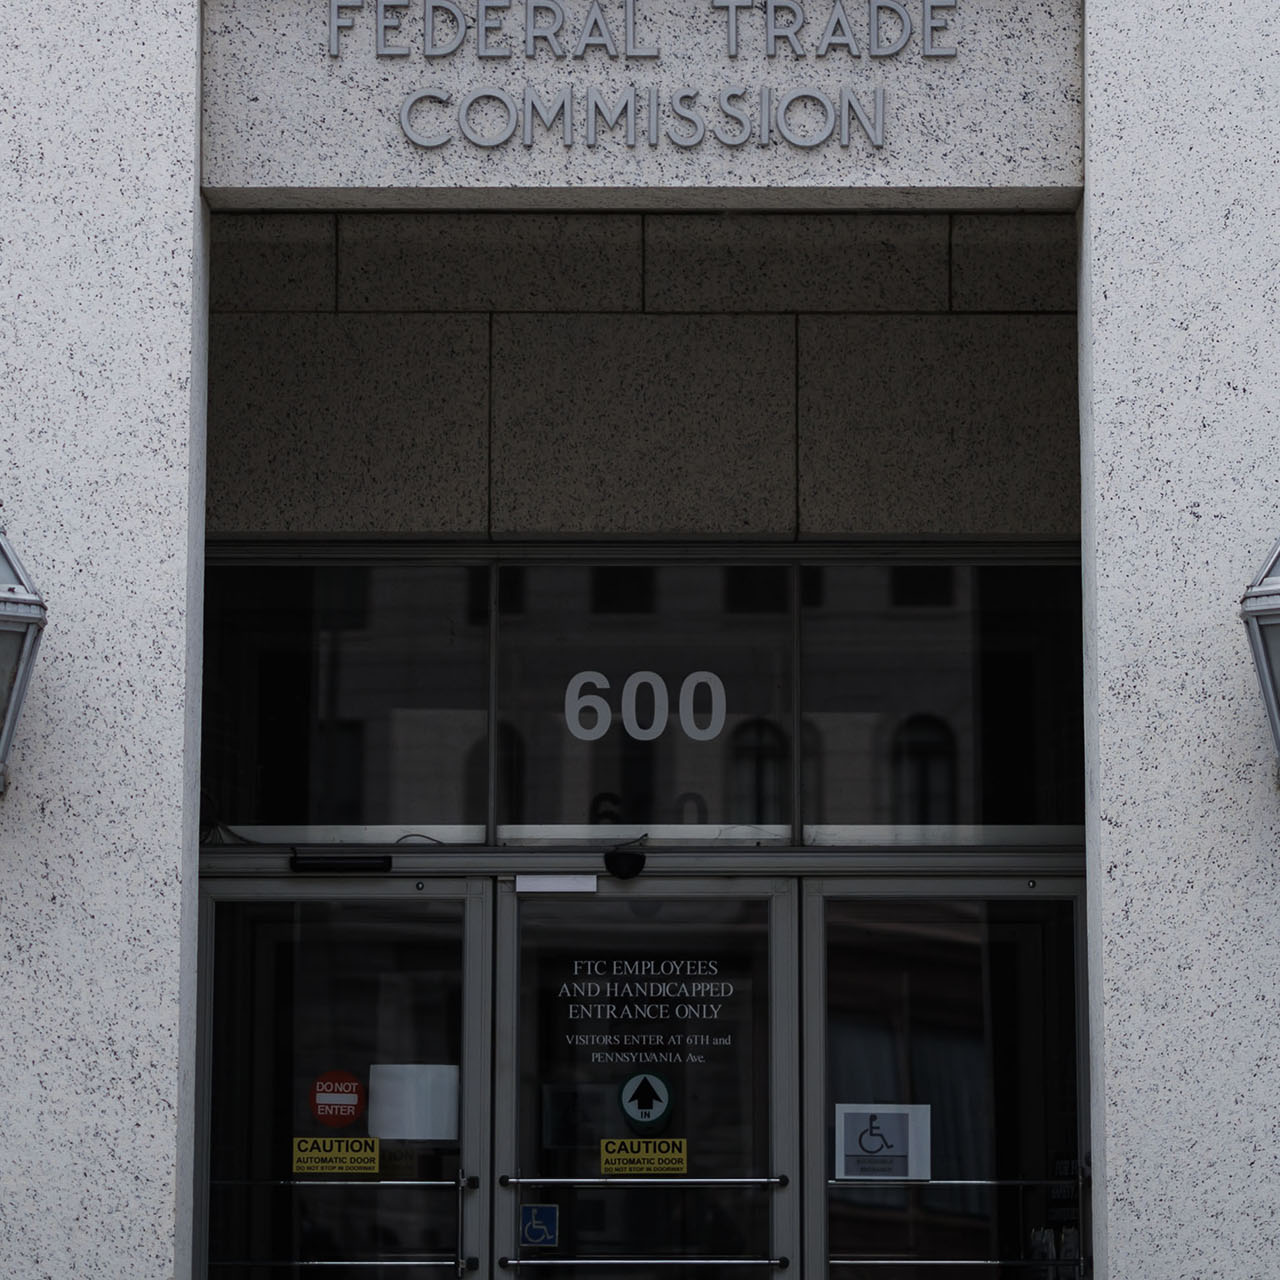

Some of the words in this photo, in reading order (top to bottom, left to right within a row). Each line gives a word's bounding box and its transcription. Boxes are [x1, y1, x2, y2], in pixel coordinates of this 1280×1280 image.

[399, 85, 886, 150] COMMISSION
[564, 669, 728, 742] 600
[573, 960, 607, 976] FTC
[613, 960, 718, 976] EMPLOYEES
[558, 982, 600, 998] AND
[606, 982, 734, 998] HANDICAPPED
[568, 1004, 670, 1020] ENTRANCE
[675, 1004, 722, 1020] ONLY
[566, 1034, 620, 1046] VISITORS
[624, 1034, 664, 1046] ENTER
[667, 1034, 683, 1046] AT
[686, 1034, 709, 1046] 6TH
[712, 1034, 732, 1046] and
[591, 1052, 682, 1064] PENNSYLVANIA
[316, 1081, 334, 1092] DO
[334, 1081, 359, 1092] NOT
[318, 1105, 356, 1116] ENTER
[640, 1111, 651, 1119] IN
[297, 1139, 375, 1153] CAUTION
[605, 1141, 682, 1154] CAUTION
[296, 1156, 348, 1164] AUTOMATIC
[350, 1156, 376, 1164] DOOR
